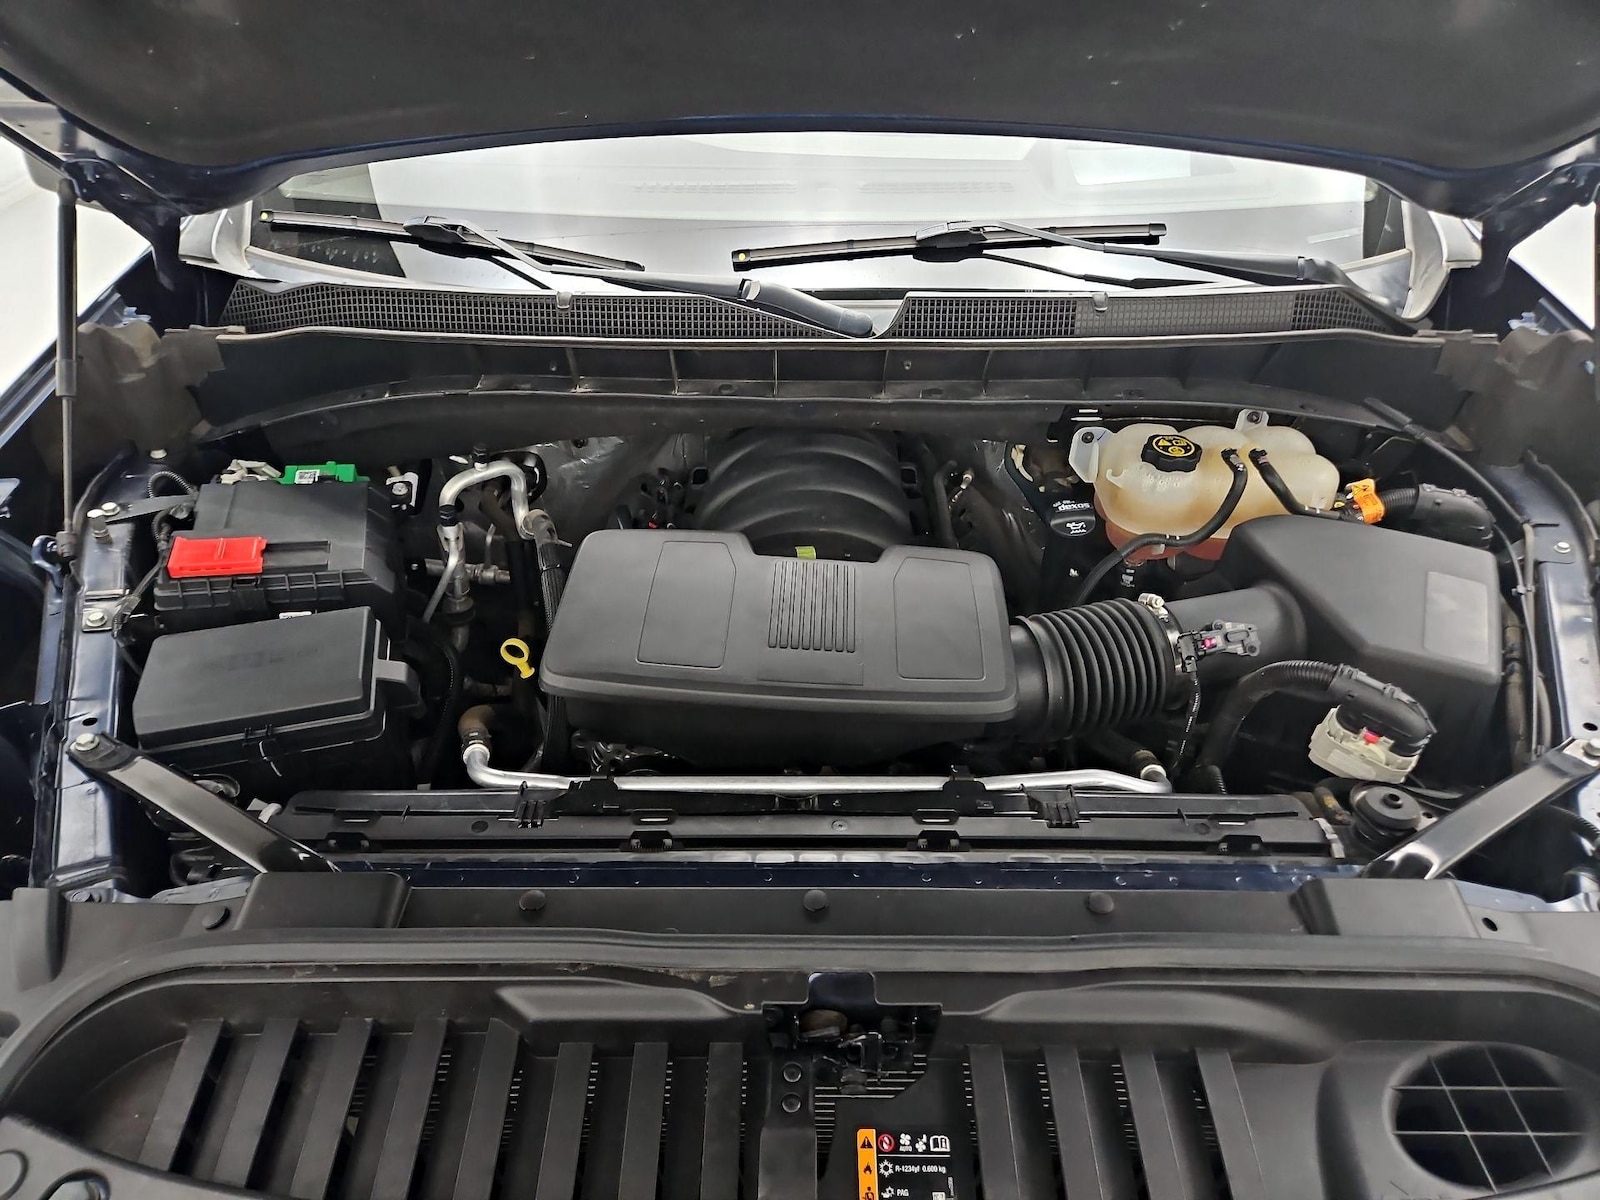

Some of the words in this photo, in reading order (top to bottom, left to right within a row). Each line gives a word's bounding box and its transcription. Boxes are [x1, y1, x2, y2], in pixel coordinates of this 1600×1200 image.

[1058, 503, 1090, 511] dexos
[895, 1165, 920, 1173] R-1234yf
[938, 1165, 946, 1174] kg
